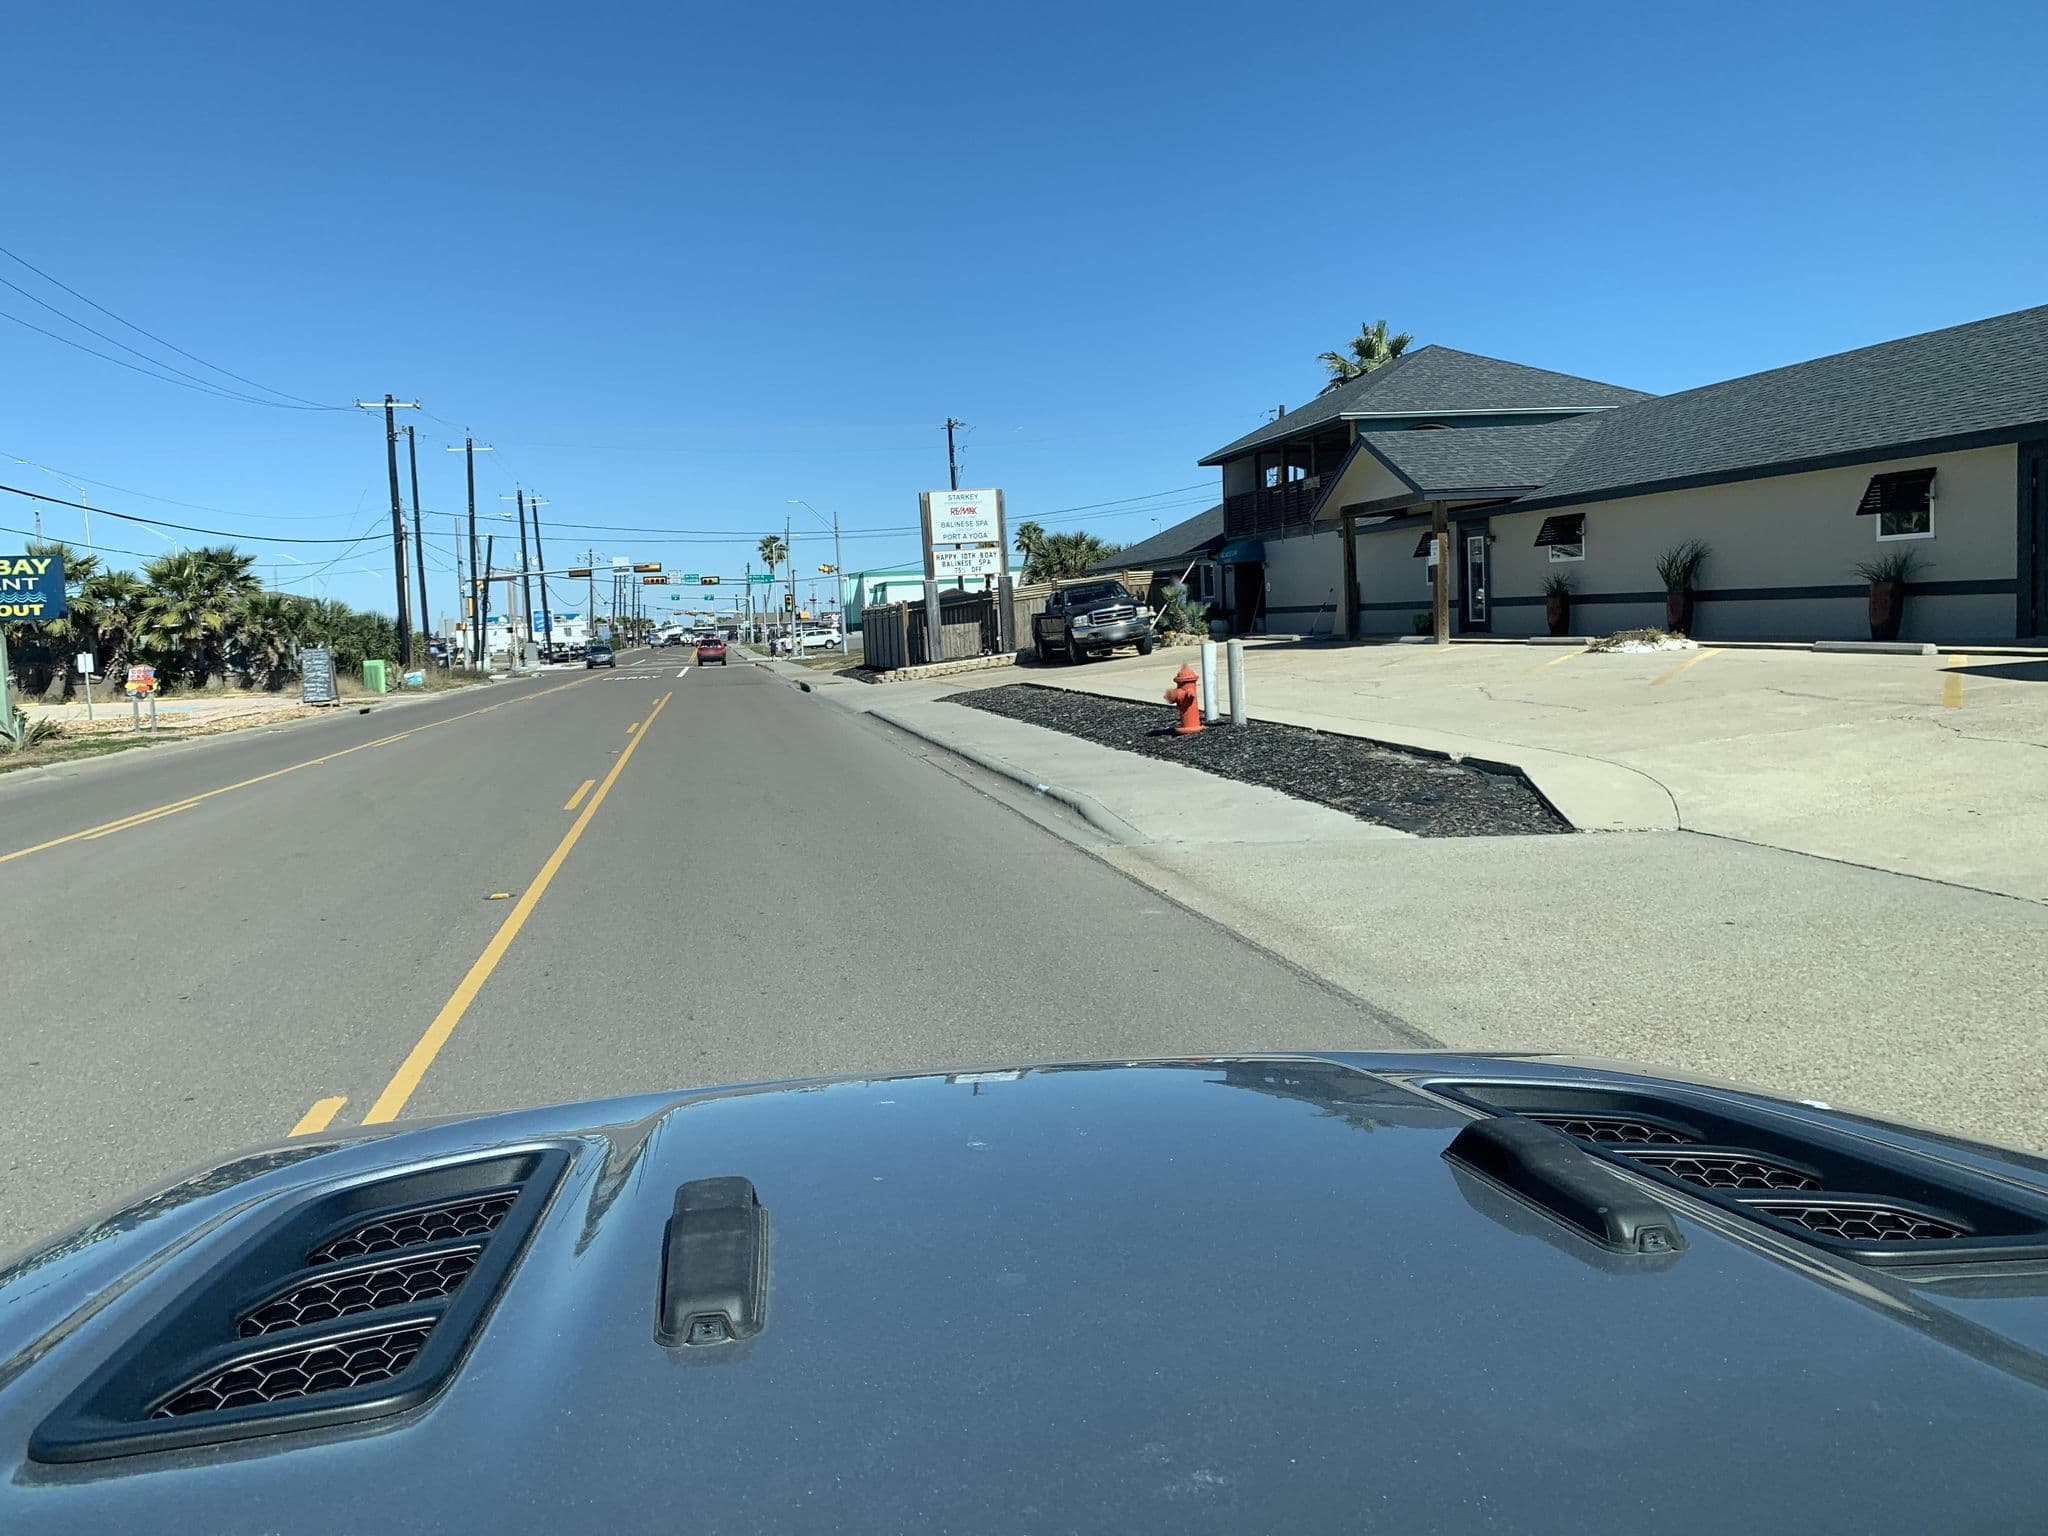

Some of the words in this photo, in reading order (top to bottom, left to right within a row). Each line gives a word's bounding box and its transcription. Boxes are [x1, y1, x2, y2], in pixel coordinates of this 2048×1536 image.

[947, 493, 979, 501] STARKEY
[950, 506, 977, 515] RE/MAX
[940, 520, 974, 529] BALINESE
[975, 519, 988, 527] SPA
[942, 533, 961, 541] PORT
[969, 532, 988, 540] YOGA
[935, 553, 957, 561] HAPPY
[0, 558, 52, 575] BAY
[941, 559, 972, 567] BALINESE
[978, 558, 991, 566] SPA
[971, 566, 982, 574] OFF
[0, 577, 39, 590] NT
[0, 603, 44, 617] OUT
